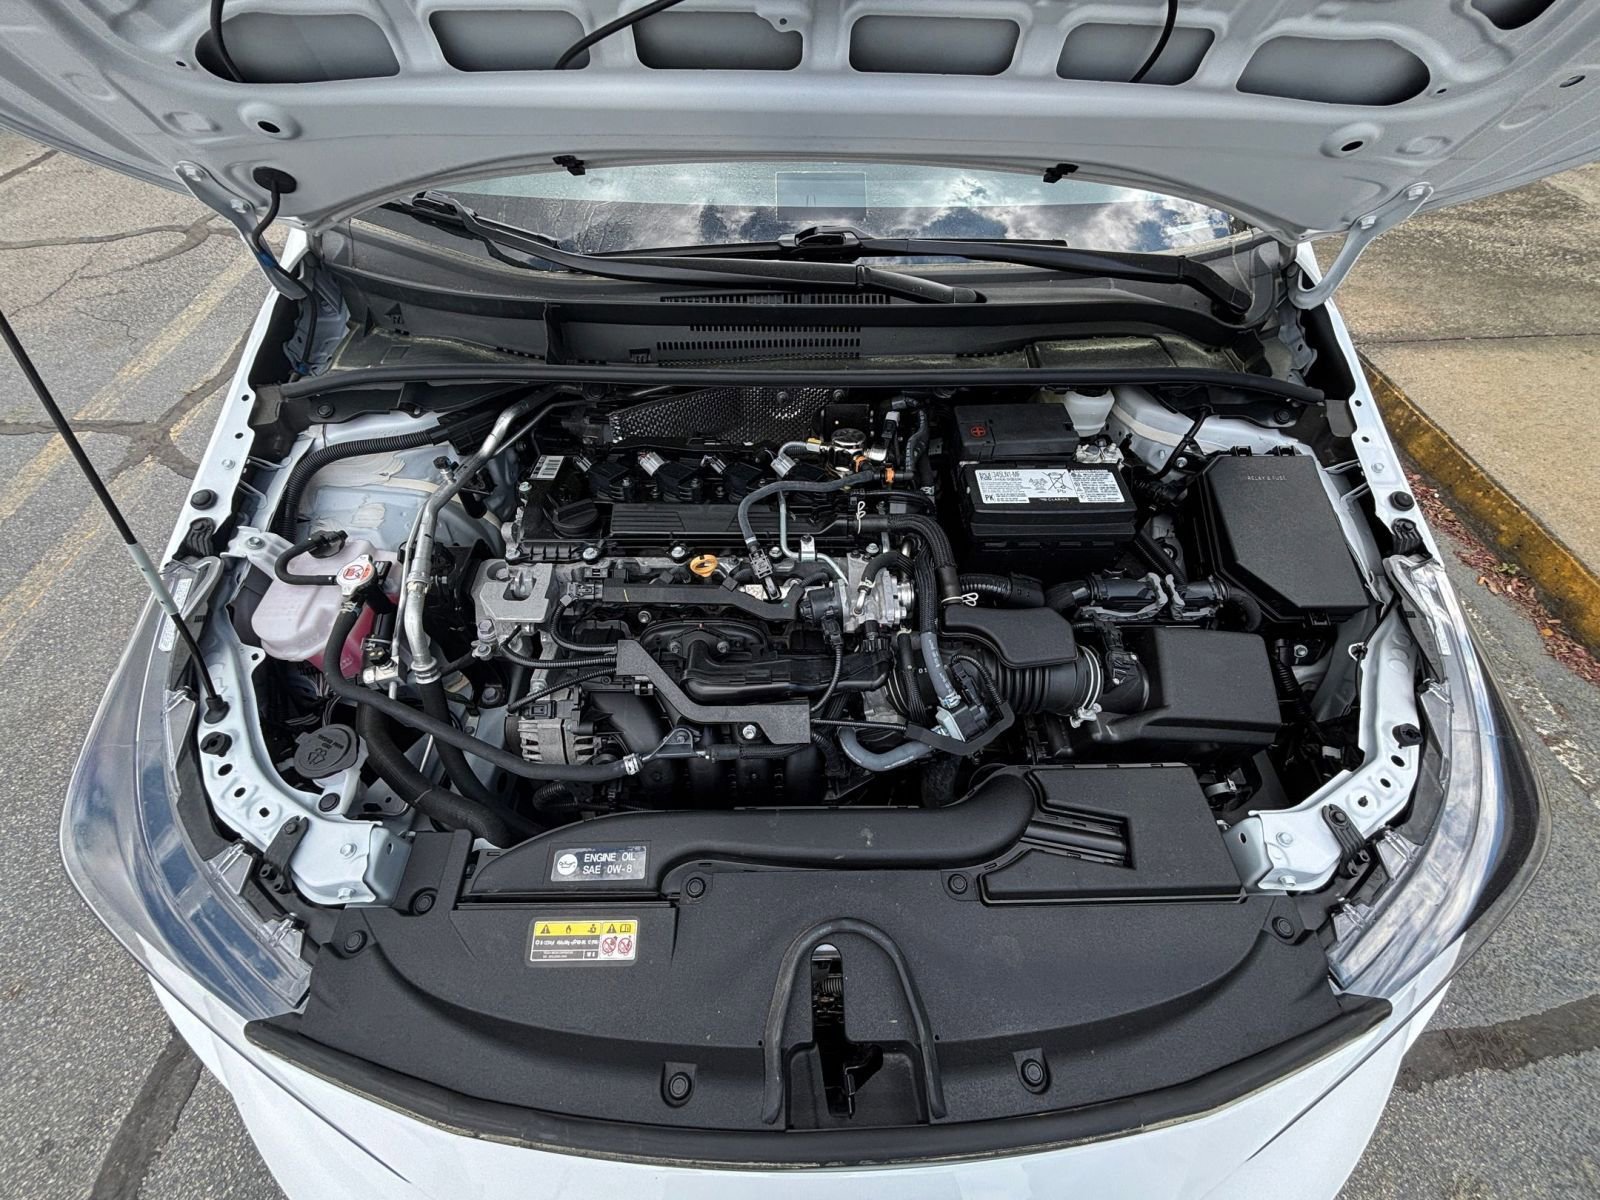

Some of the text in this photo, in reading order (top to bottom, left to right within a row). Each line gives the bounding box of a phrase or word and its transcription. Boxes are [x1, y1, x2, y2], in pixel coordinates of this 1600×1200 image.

[584, 851, 636, 863] ENGINE OIL
[582, 864, 633, 875] SAE 0W-8
